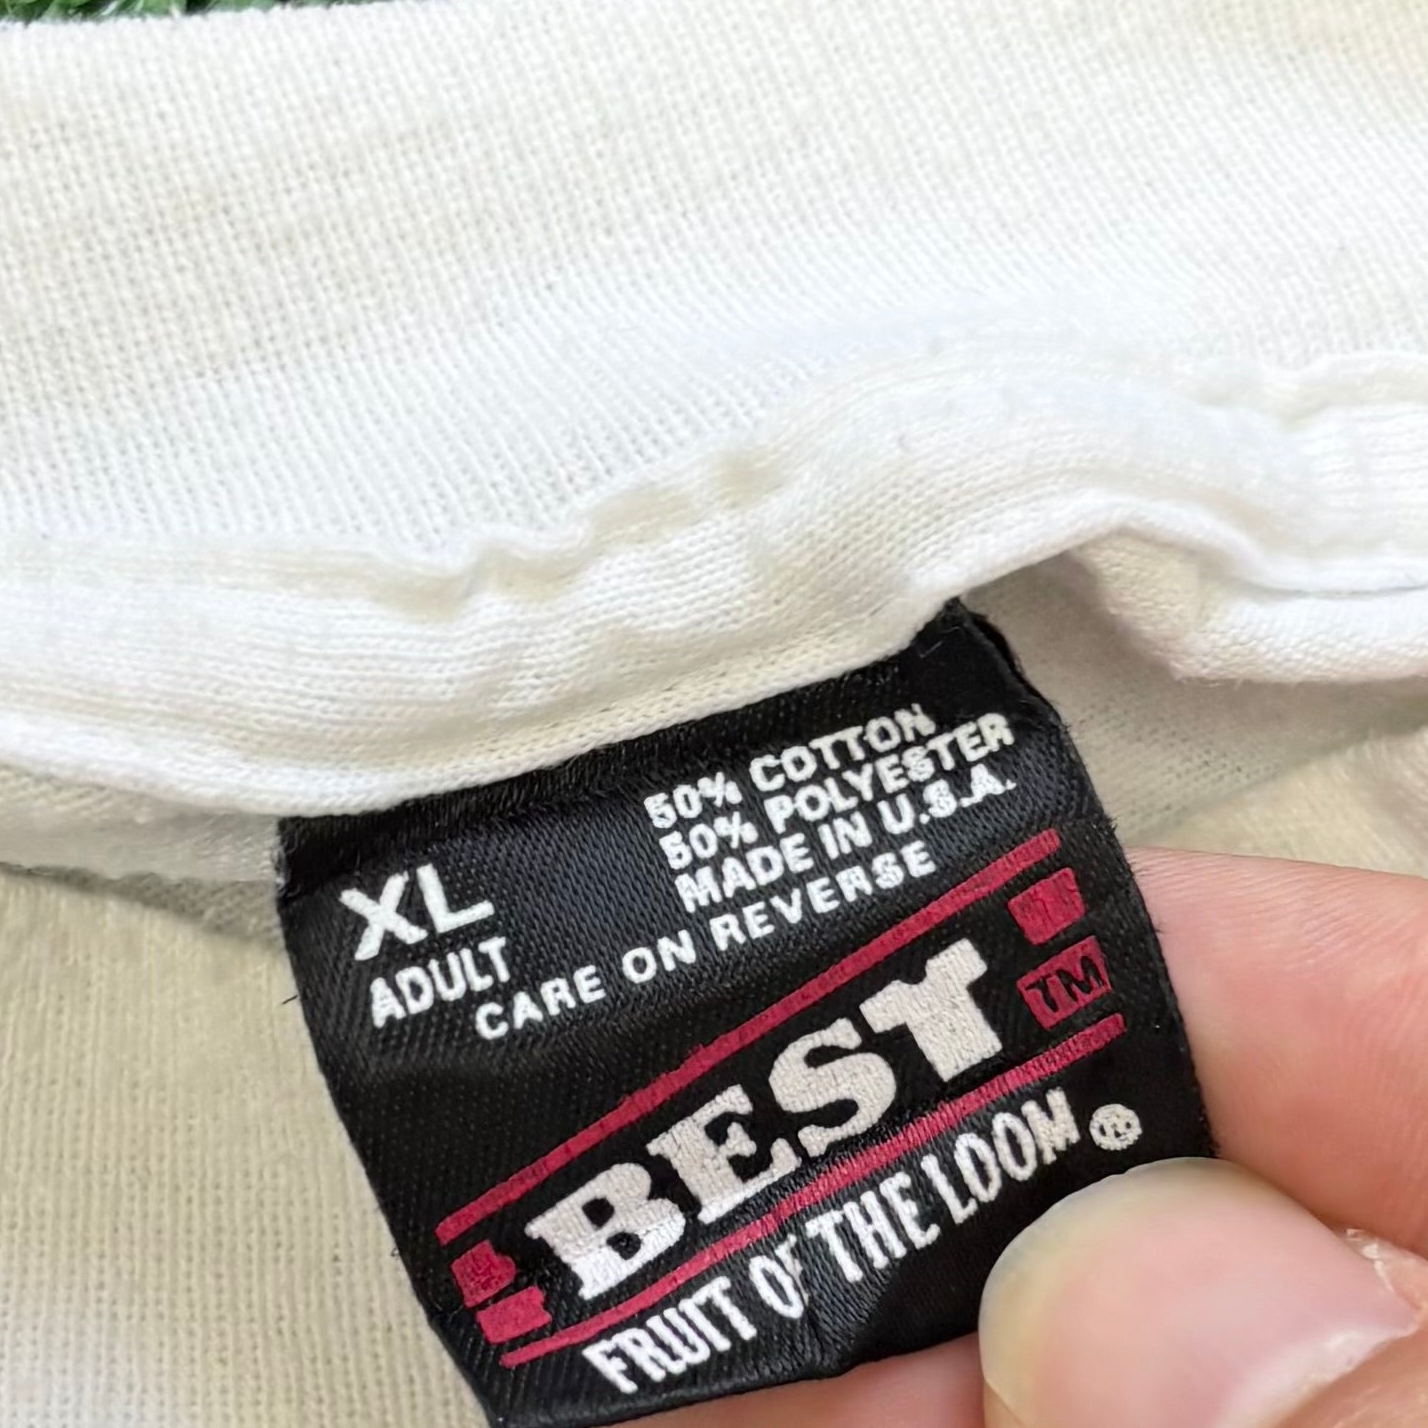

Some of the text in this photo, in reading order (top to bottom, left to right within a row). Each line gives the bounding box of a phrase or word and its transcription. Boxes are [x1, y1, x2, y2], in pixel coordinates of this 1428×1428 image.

[644, 703, 936, 829] 50% COTTON
[659, 712, 1014, 870] 50% POLYESTER
[674, 763, 1017, 913] MADE IN U.S.A.
[339, 862, 495, 962] XL
[370, 936, 507, 1029] ADULT
[474, 840, 936, 1040] CARE ON REVERSE
[524, 937, 1003, 1300] BEST
[582, 1277, 758, 1394] FRUIT
[804, 1172, 941, 1282] THE
